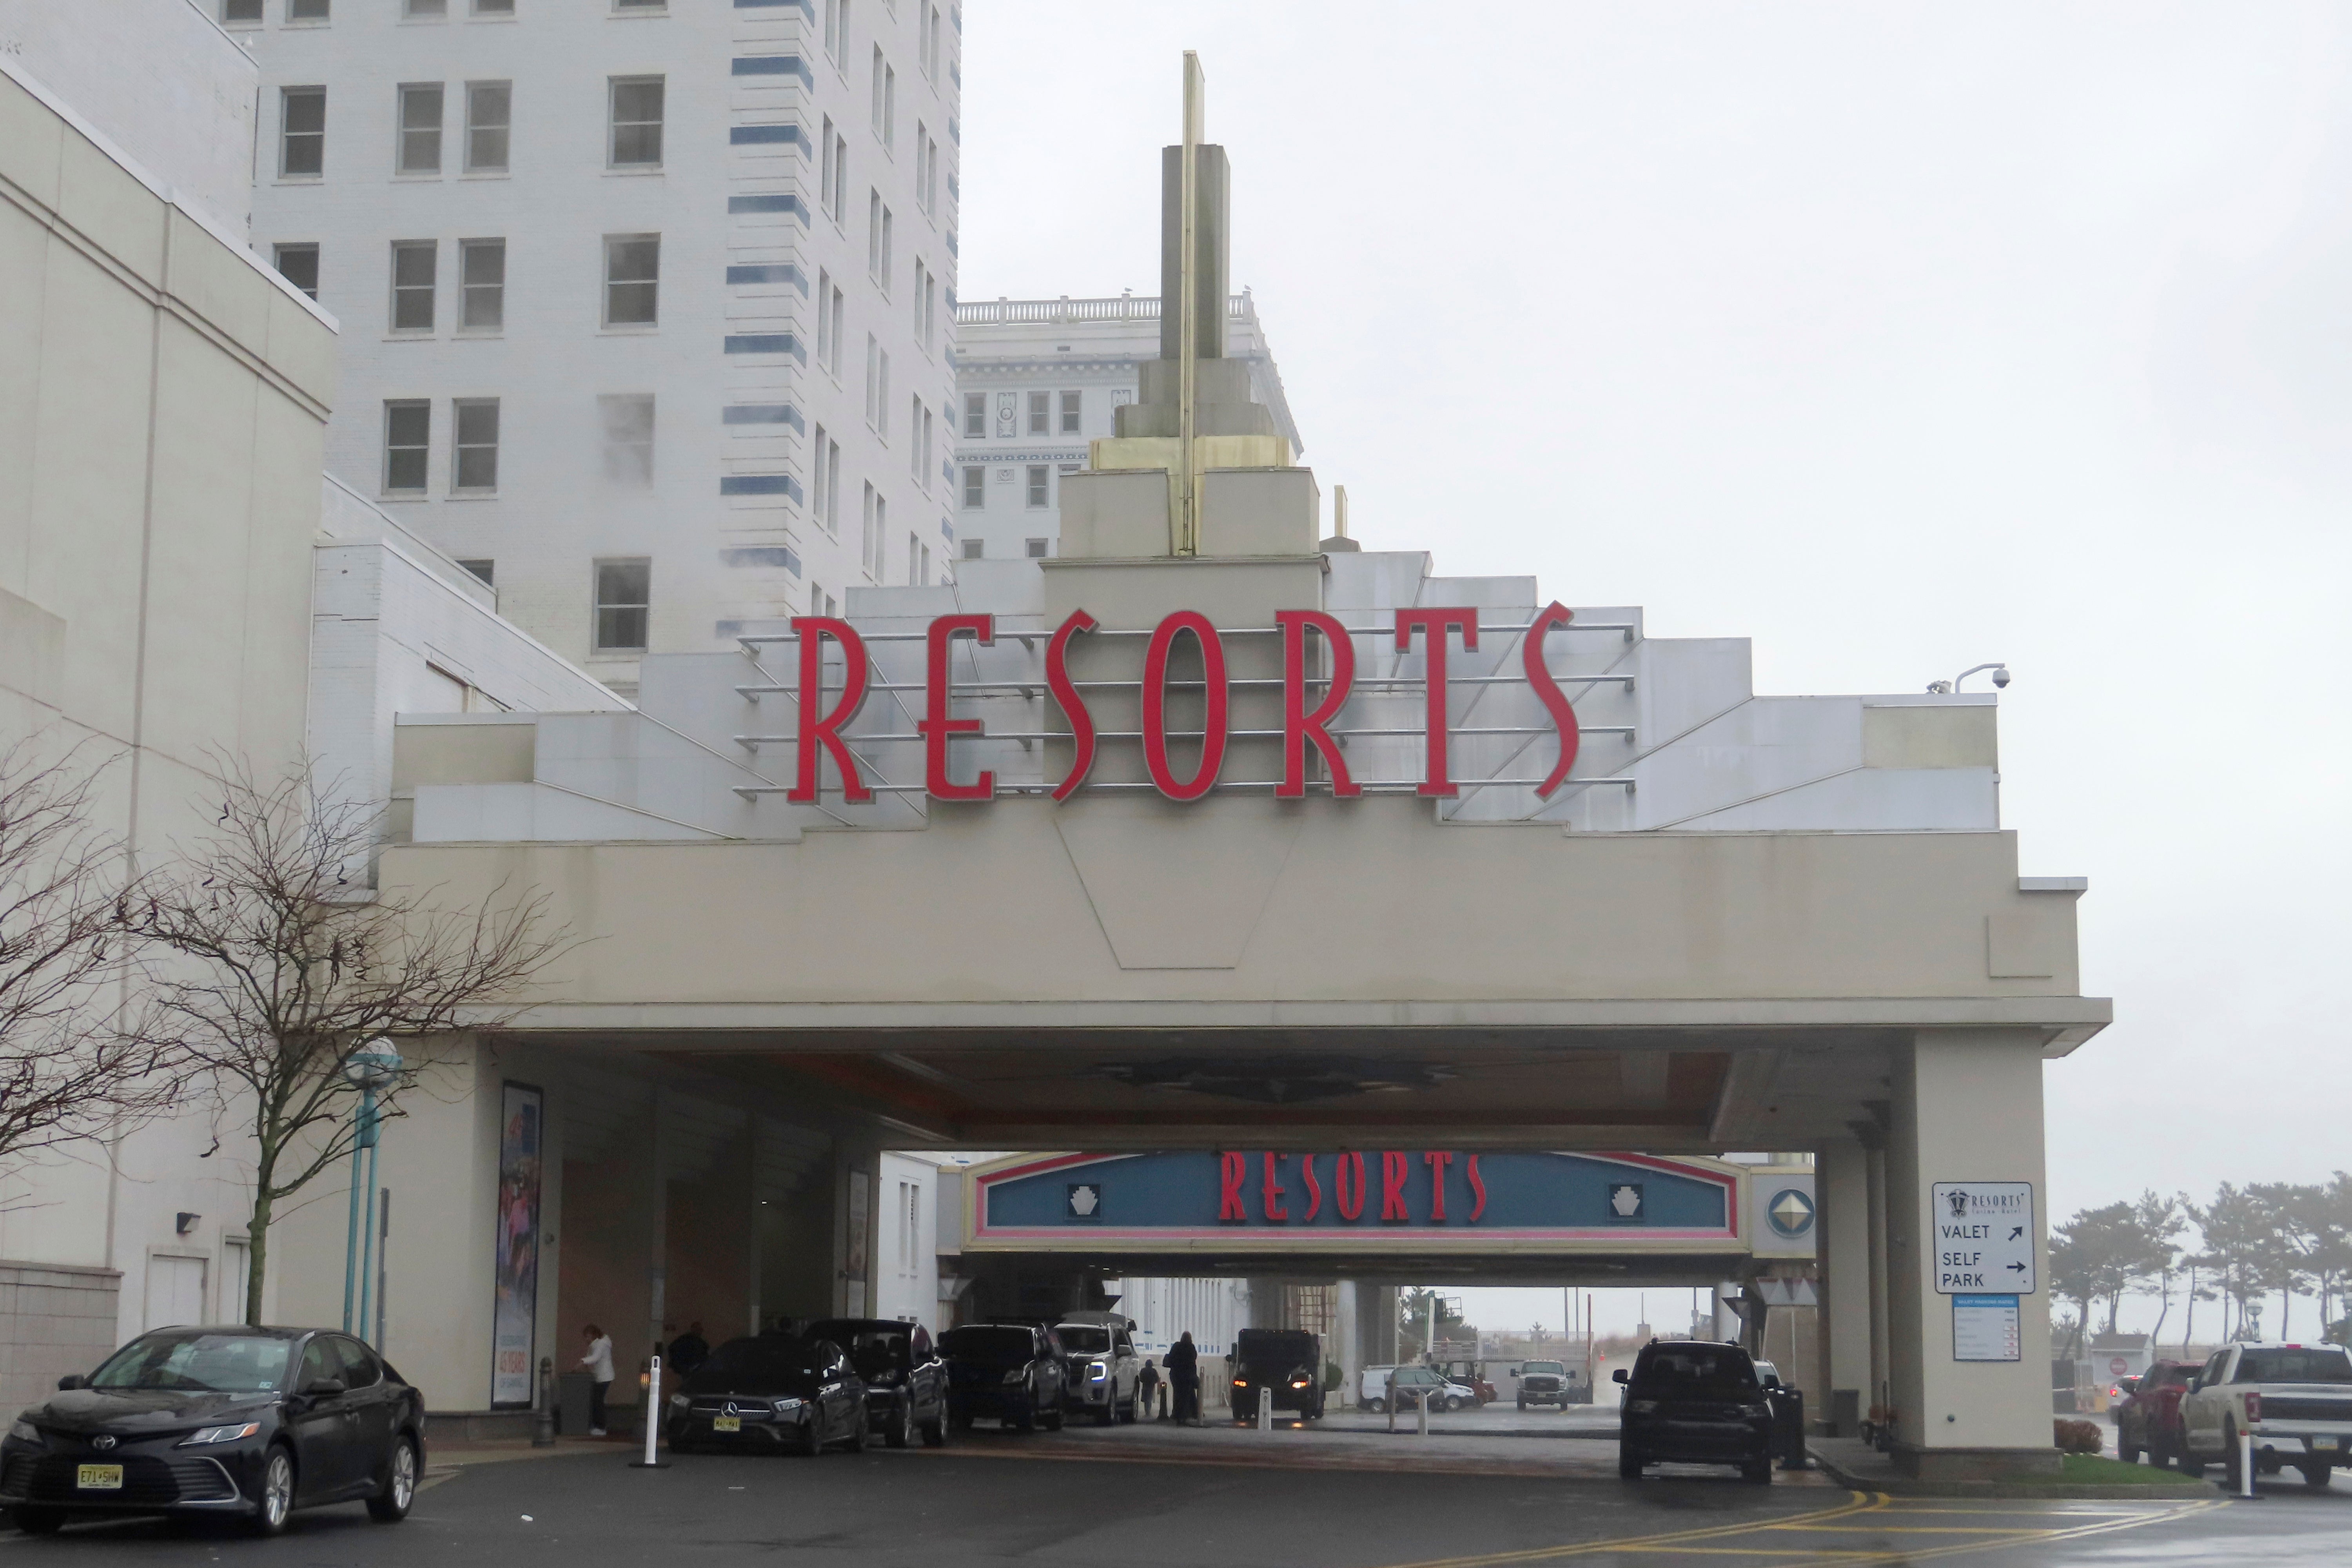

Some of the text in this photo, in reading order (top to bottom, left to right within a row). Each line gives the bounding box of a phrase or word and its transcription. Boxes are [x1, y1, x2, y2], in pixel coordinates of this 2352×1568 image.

[788, 601, 1580, 805] RESORTS
[1218, 1151, 1486, 1221] RESORTS
[1972, 1196, 2020, 1206] RESORTS
[1942, 1225, 1989, 1238] VALET
[1943, 1252, 1981, 1265] SELF
[1943, 1274, 1984, 1287] PARK
